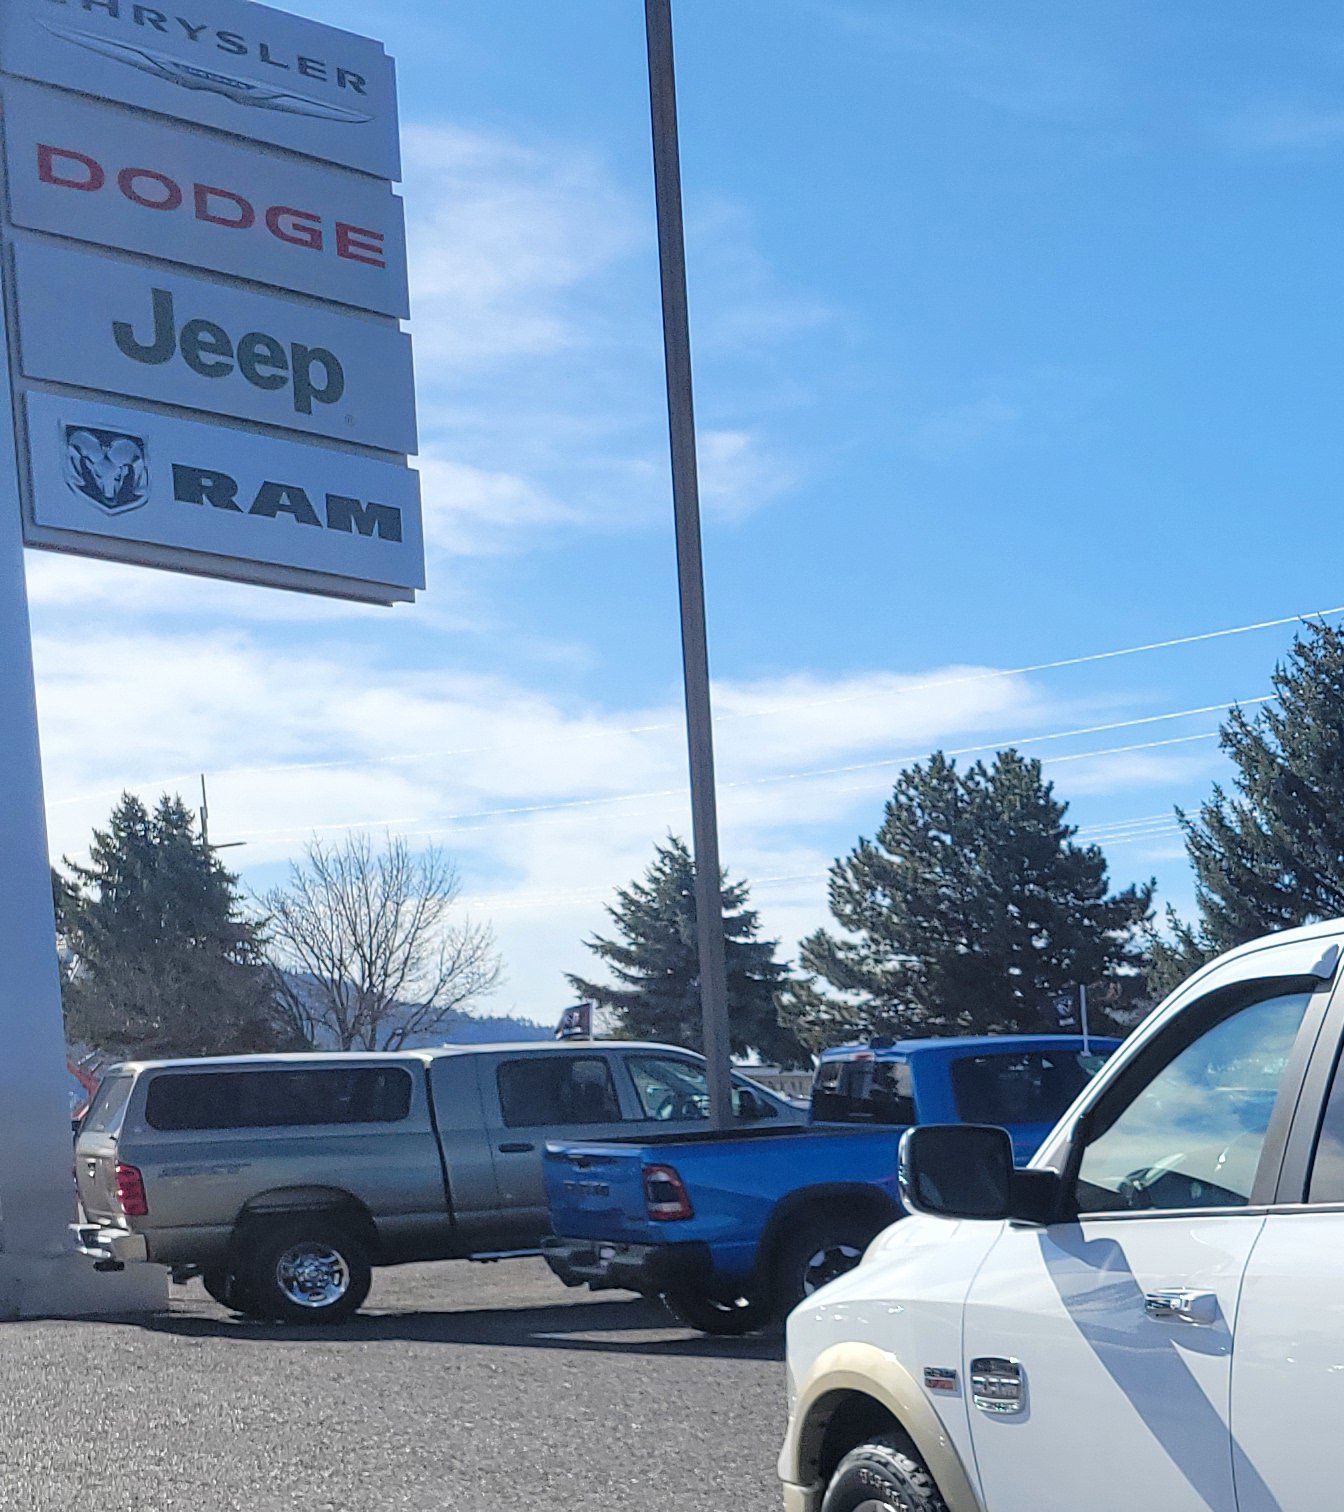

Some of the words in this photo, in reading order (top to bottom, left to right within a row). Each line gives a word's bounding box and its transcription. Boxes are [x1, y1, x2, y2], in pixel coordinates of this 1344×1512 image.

[50, 0, 368, 96] HRYSLER
[36, 143, 387, 269] DODGE
[112, 287, 345, 416] Jeep
[171, 463, 403, 543] RAM
